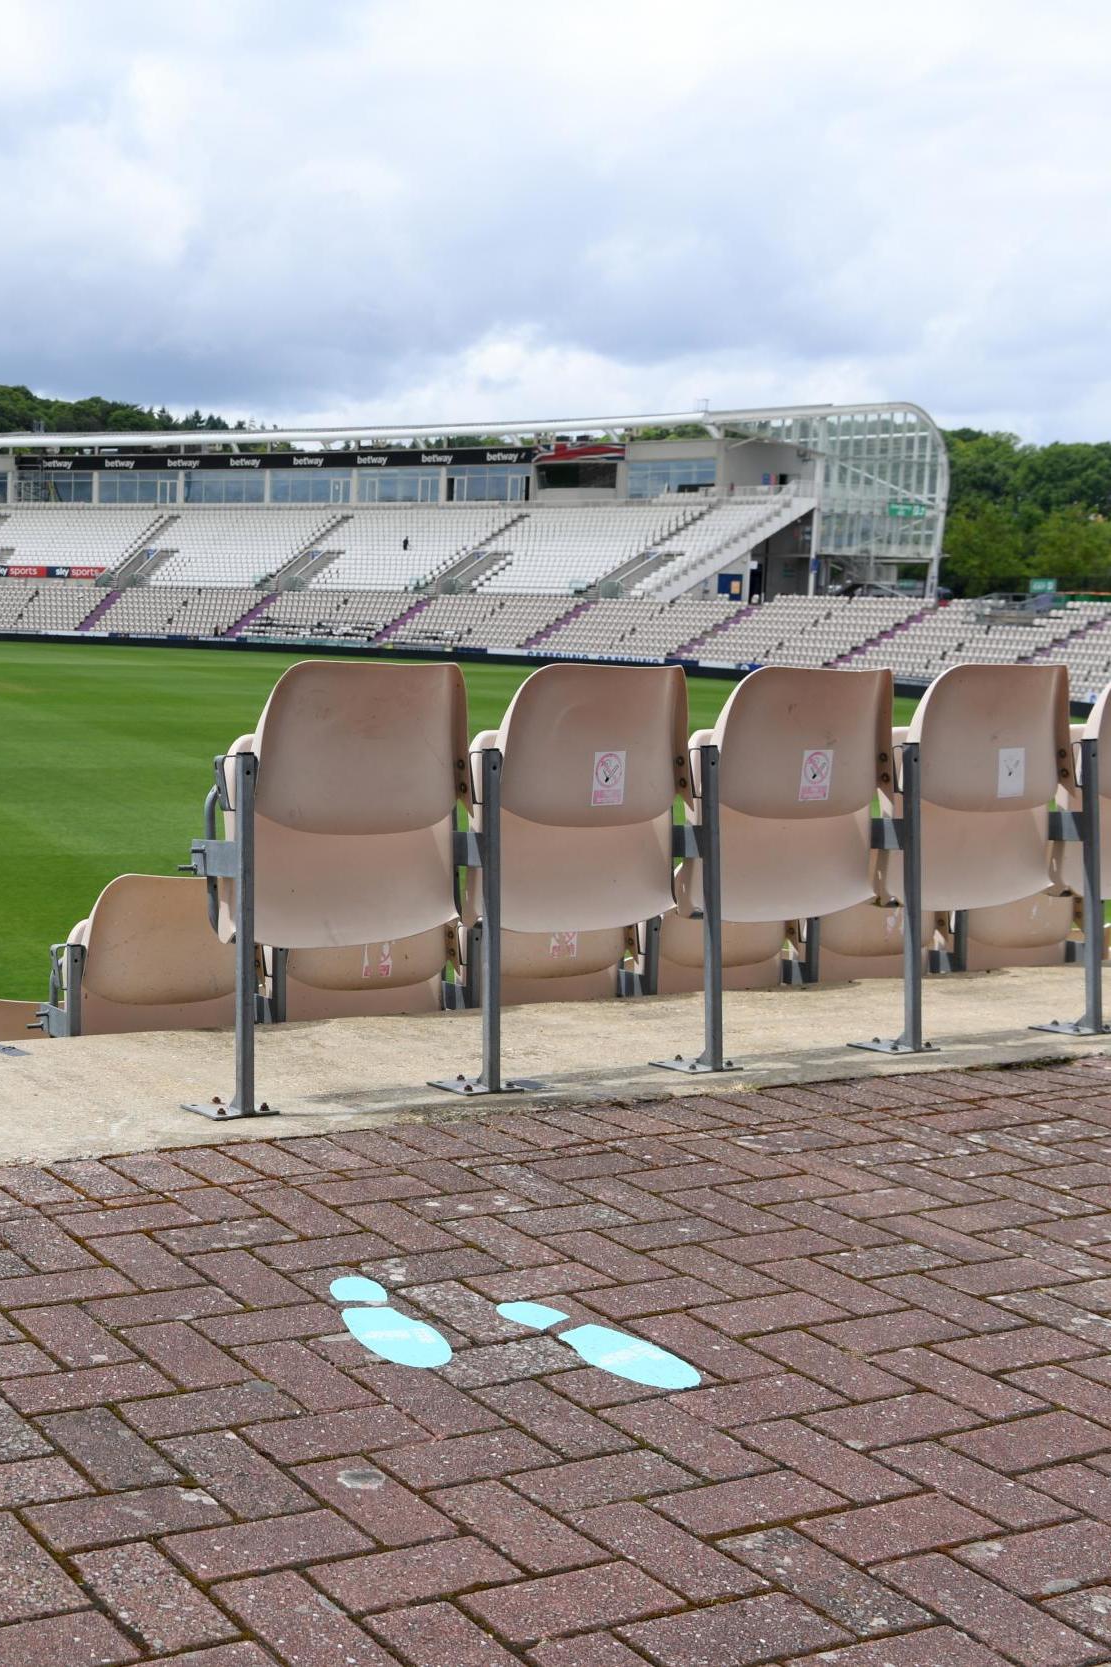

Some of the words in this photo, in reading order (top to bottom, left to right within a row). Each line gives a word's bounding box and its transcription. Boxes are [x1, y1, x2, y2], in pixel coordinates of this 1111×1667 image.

[293, 456, 324, 467] betway
[357, 455, 388, 466] betway
[422, 453, 453, 464] betway
[486, 452, 519, 462] betway
[105, 459, 135, 469] betway
[167, 458, 197, 469] betway
[229, 458, 261, 468] betway
[10, 566, 38, 576] sports
[55, 567, 70, 577] sky
